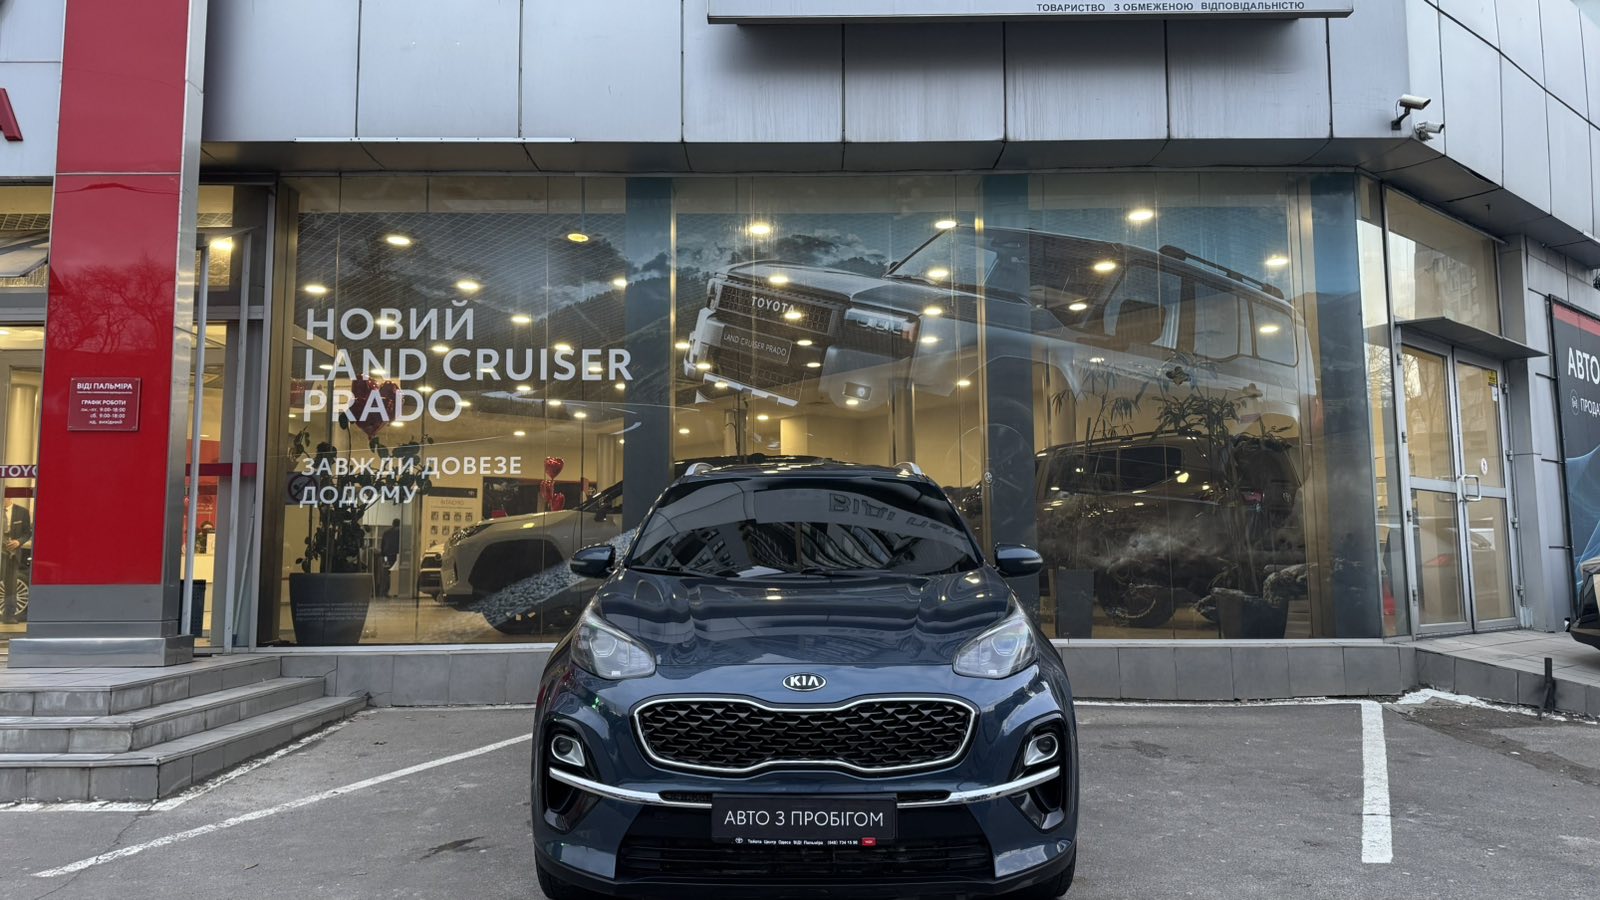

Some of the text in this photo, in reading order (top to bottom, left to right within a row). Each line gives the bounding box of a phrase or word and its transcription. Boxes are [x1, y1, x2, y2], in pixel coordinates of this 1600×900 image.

[1036, 1, 1306, 13] ТОВАРИСТВО З ОБМЕЖЕНОЮ ВІДПОВІДАЛЬНІСТЮ
[751, 296, 796, 313] TOYOTA
[306, 299, 474, 341] НОВИЙ
[723, 333, 787, 356] LAND CRUISER PRADO
[304, 348, 634, 381] LAND CRUISER
[1568, 346, 1600, 385] АВТО
[76, 382, 133, 391] ВІДІ ПАЛЬМІРА
[302, 389, 463, 422] PRADO
[1580, 398, 1600, 418] ПРОДА
[301, 456, 523, 478] ЗАВЖДИ ДОВЕЗЕ
[299, 485, 418, 507] ДОДОМУ
[790, 675, 819, 687] KIA
[724, 810, 884, 827] АВТО З ПРОБІГОМ
